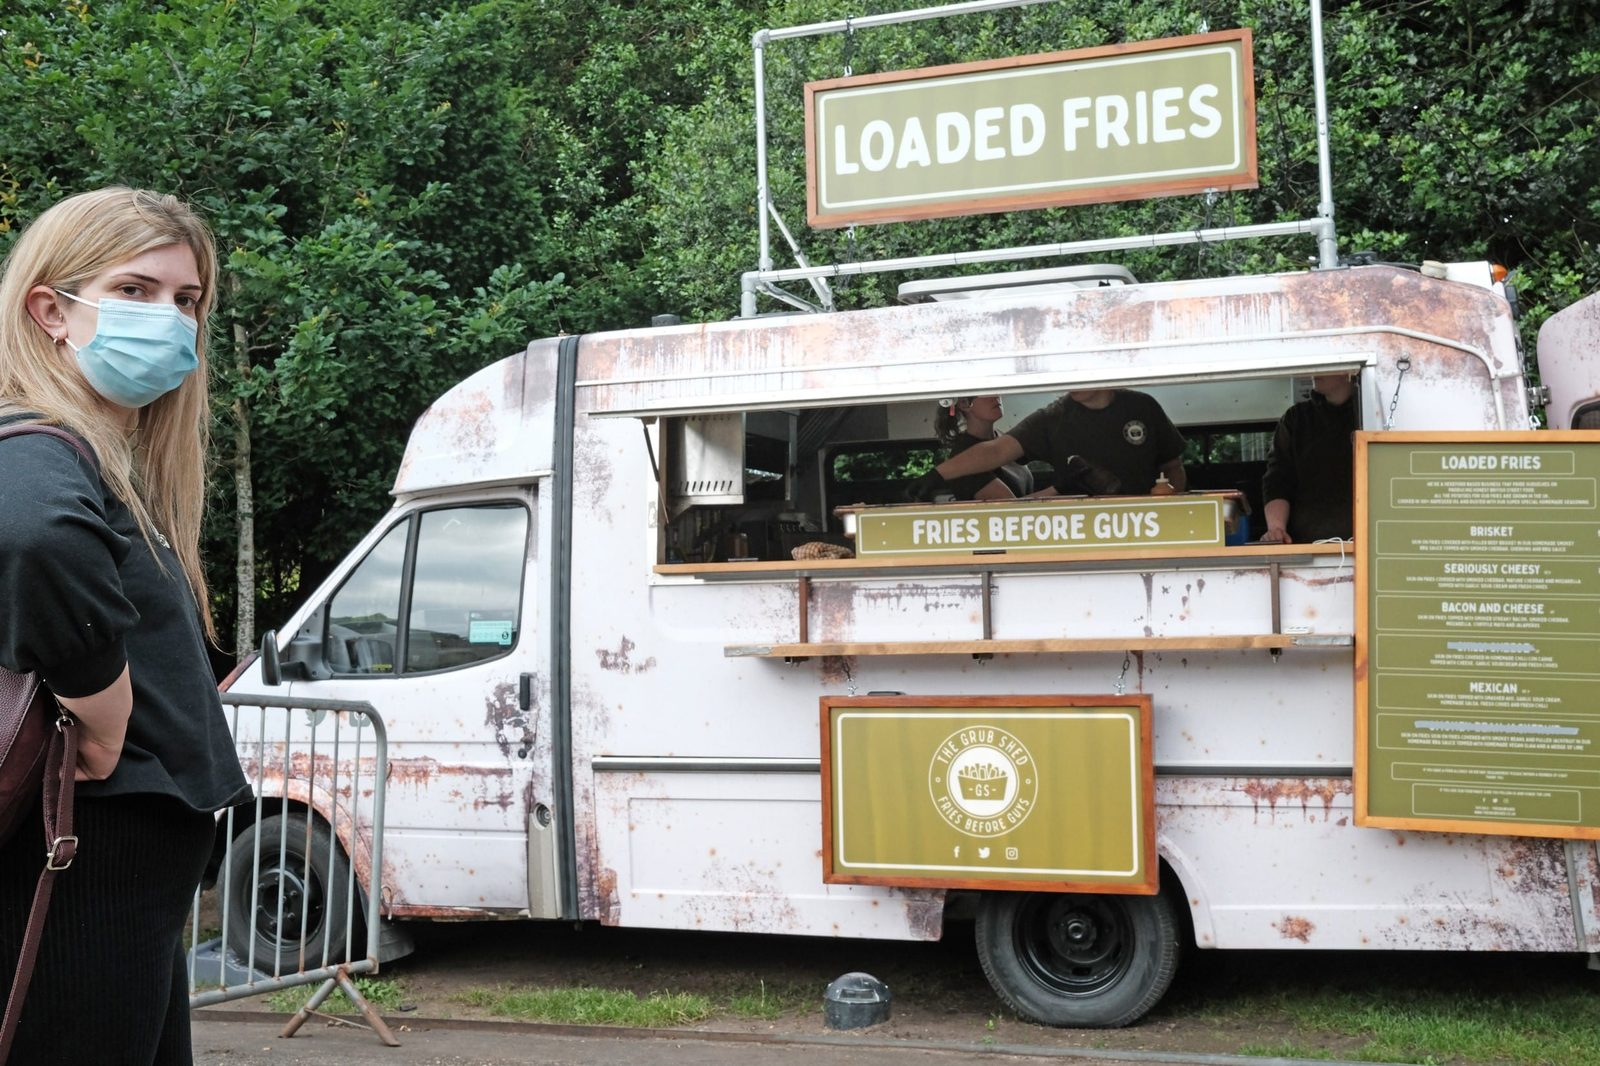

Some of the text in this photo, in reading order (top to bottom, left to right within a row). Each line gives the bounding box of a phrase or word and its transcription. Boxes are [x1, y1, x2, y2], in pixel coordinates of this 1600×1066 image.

[833, 83, 1223, 176] LOADED FRIES
[1441, 455, 1541, 470] LOADED FRIES
[912, 511, 1160, 545] FRIES BEFORE GUYS
[1470, 526, 1513, 537] BRISKET
[1444, 563, 1498, 574] SERIOUSLY
[1500, 564, 1541, 575] CHEESY
[1441, 602, 1477, 613] BACON
[1478, 603, 1501, 614] AND
[1502, 603, 1544, 614] CHEESE
[1470, 682, 1518, 694] MEXICAN
[937, 730, 1028, 766] THE GRUB SHED
[937, 795, 1030, 833] FRIES BEFORE GUYS
